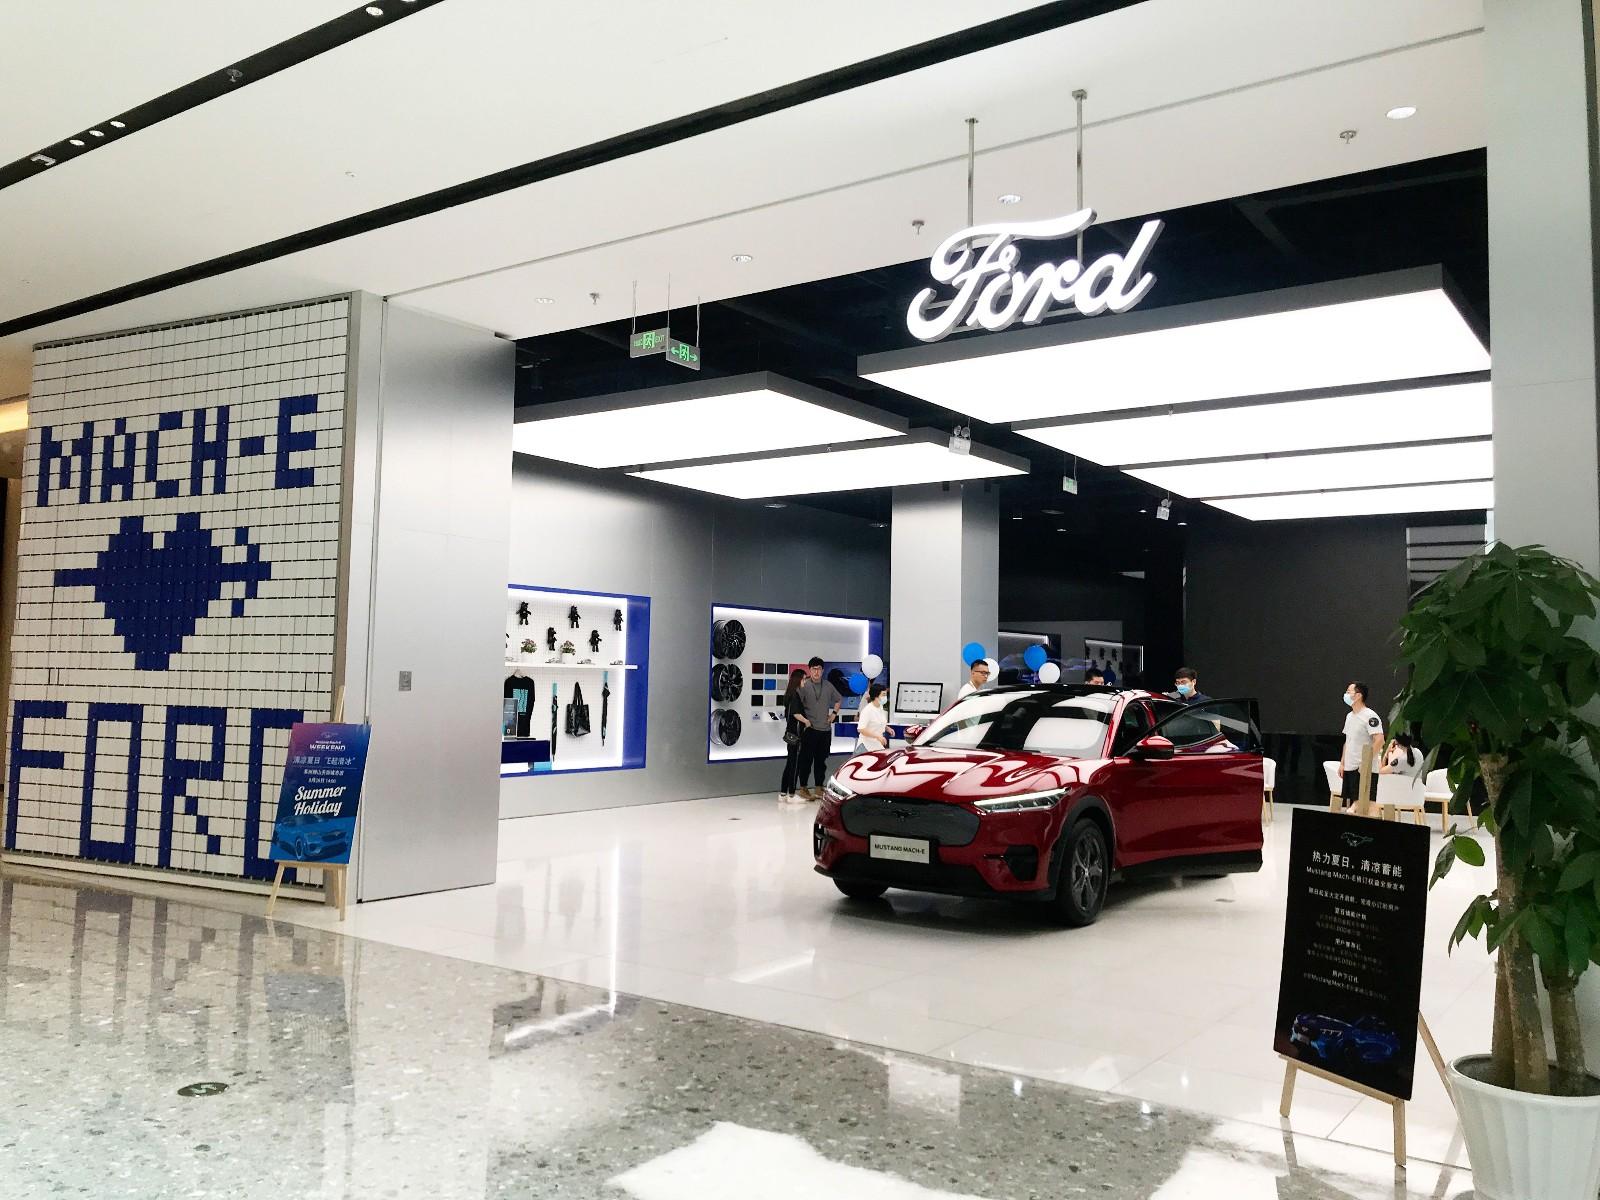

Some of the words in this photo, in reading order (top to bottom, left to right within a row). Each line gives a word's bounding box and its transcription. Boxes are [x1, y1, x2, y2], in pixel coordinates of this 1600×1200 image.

[907, 208, 1164, 342] Ford
[36, 394, 318, 507] MACH-E
[310, 744, 346, 752] WEEKEND
[295, 786, 347, 801] Summer
[294, 800, 343, 817] Holiday
[874, 843, 902, 852] MUSTANG
[903, 847, 926, 855] MACH-E
[1306, 865, 1332, 878] Mustang
